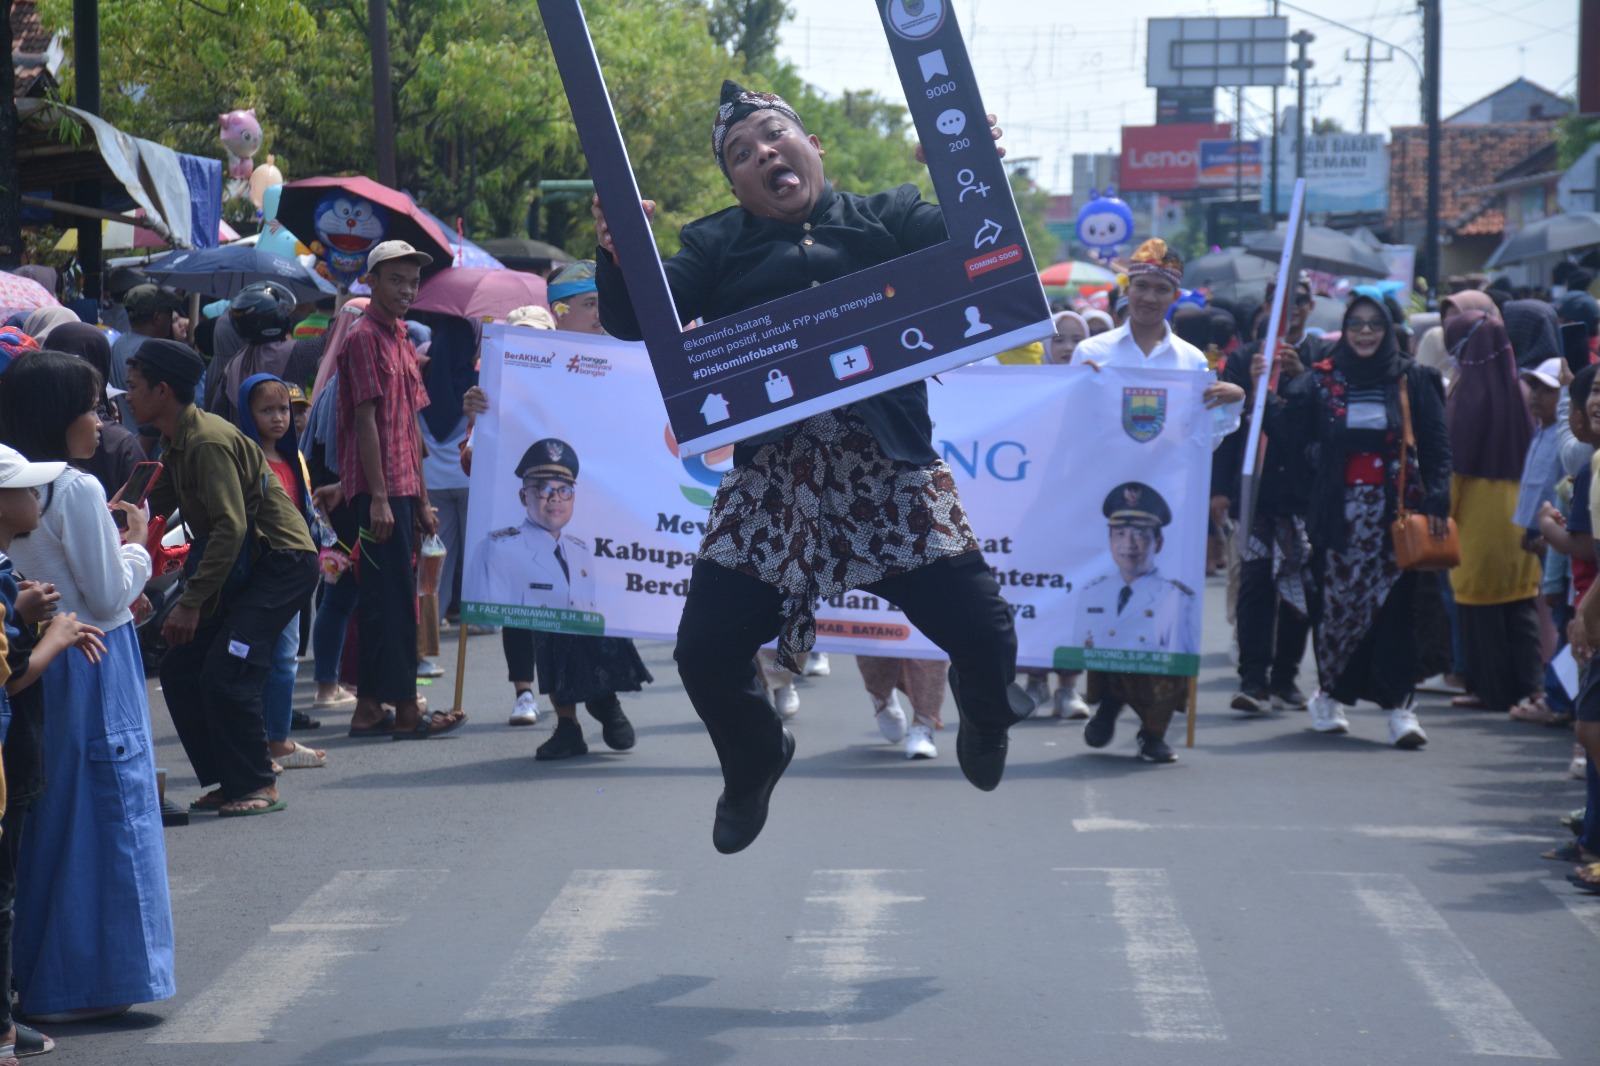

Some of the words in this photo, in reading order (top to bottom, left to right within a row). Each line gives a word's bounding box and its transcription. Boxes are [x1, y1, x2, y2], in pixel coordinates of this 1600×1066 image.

[925, 81, 957, 99] 9000
[949, 138, 971, 153] 200
[1129, 148, 1200, 169] Lenov
[969, 257, 997, 272] COMING
[997, 248, 1020, 264] SOON
[683, 313, 772, 351] @kominfo.batang
[688, 343, 724, 365] Konten
[724, 332, 760, 356] positif,
[761, 323, 792, 342] untuk
[792, 315, 812, 334] FYP
[812, 307, 839, 328] yang
[839, 291, 883, 315] menyala
[504, 351, 554, 365] BerAKHLAK
[692, 337, 799, 381] #Diskominfobatang
[479, 604, 499, 614] FAIZ
[827, 592, 880, 611] dan
[504, 616, 531, 626] Bupati
[531, 618, 561, 629] Batang
[817, 621, 849, 634] KAB.
[850, 625, 904, 638] BATANG
